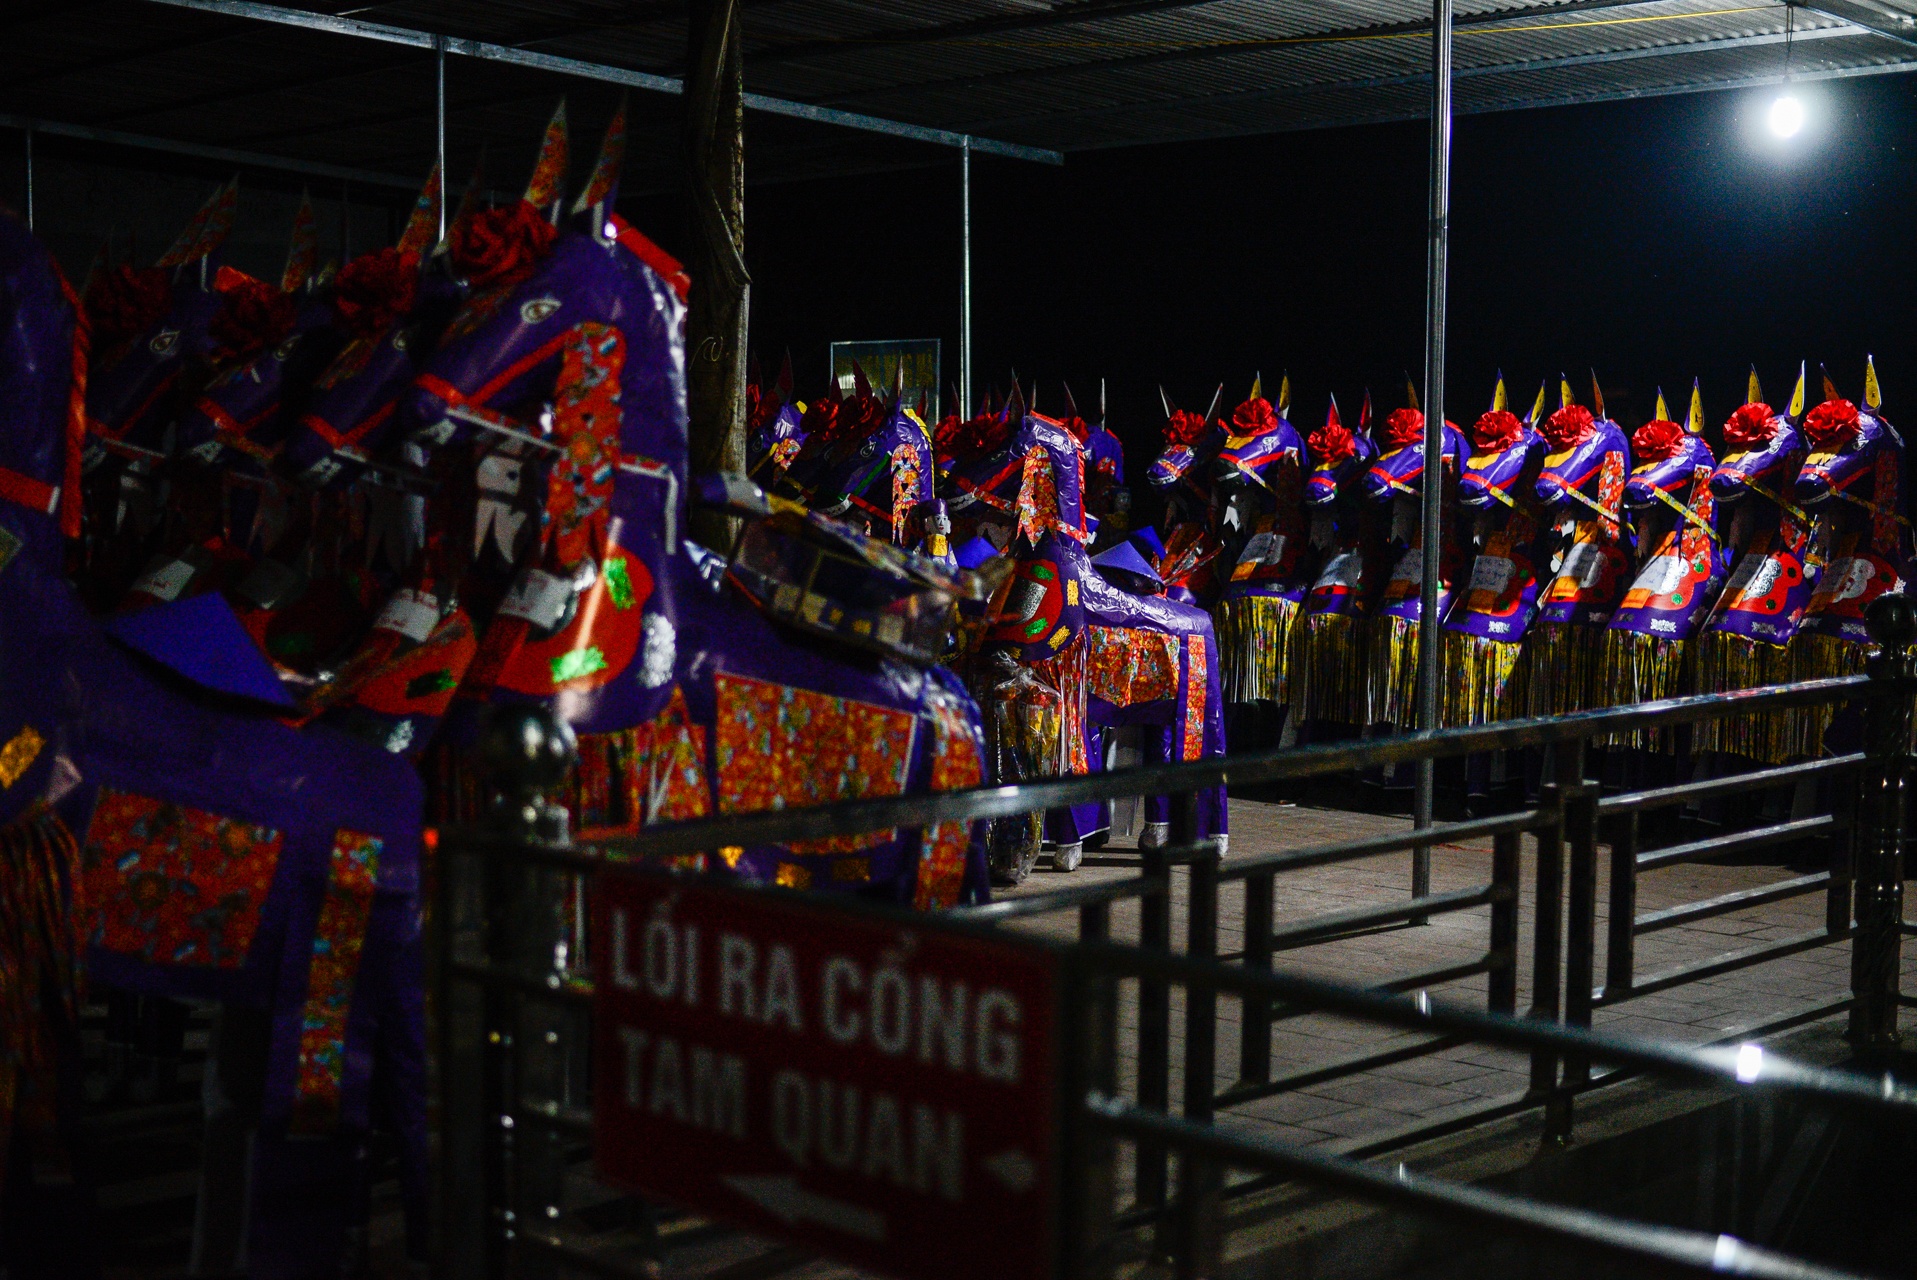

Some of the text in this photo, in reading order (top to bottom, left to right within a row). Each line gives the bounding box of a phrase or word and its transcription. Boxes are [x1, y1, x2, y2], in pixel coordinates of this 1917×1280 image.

[608, 886, 1025, 1084] LỐI RA CỔNG
[616, 1023, 967, 1202] TAM QUAN
